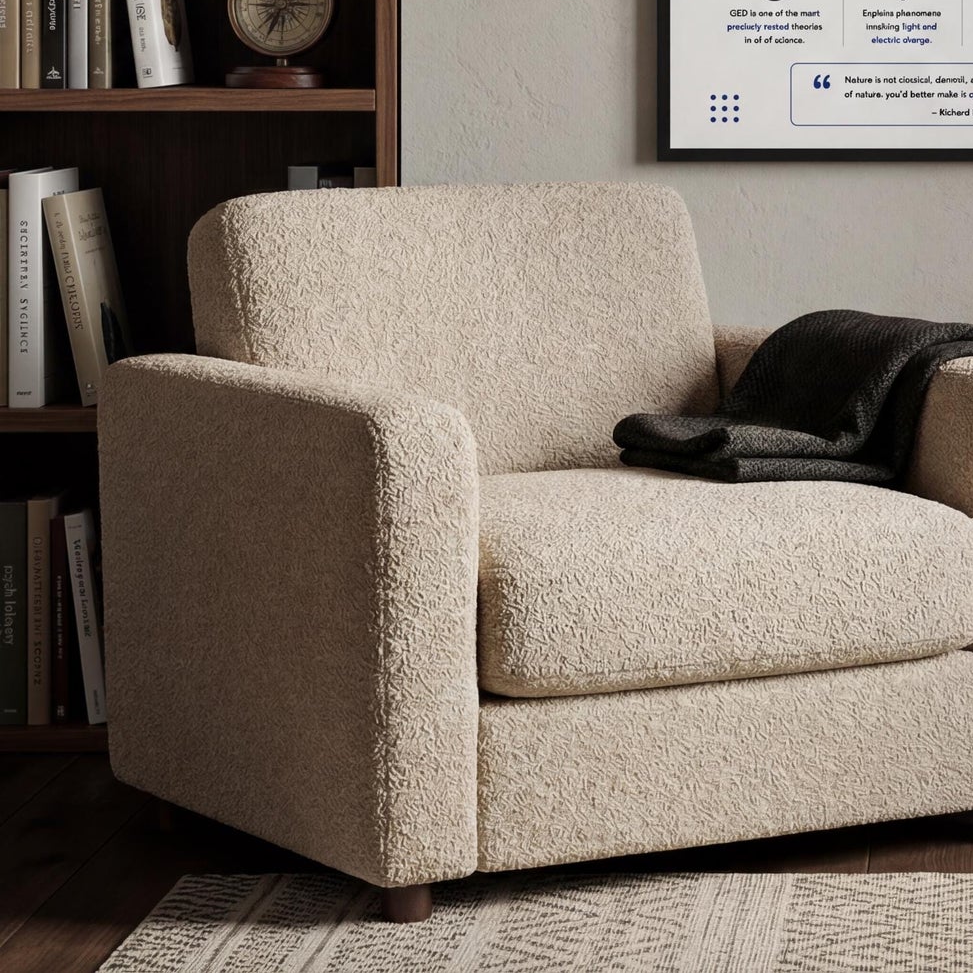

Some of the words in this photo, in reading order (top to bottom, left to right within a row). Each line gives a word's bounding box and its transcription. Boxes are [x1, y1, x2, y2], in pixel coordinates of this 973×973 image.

[730, 9, 748, 17] GED
[775, 9, 783, 17] of
[785, 9, 798, 17] the
[844, 90, 853, 98] of
[910, 90, 935, 98] better
